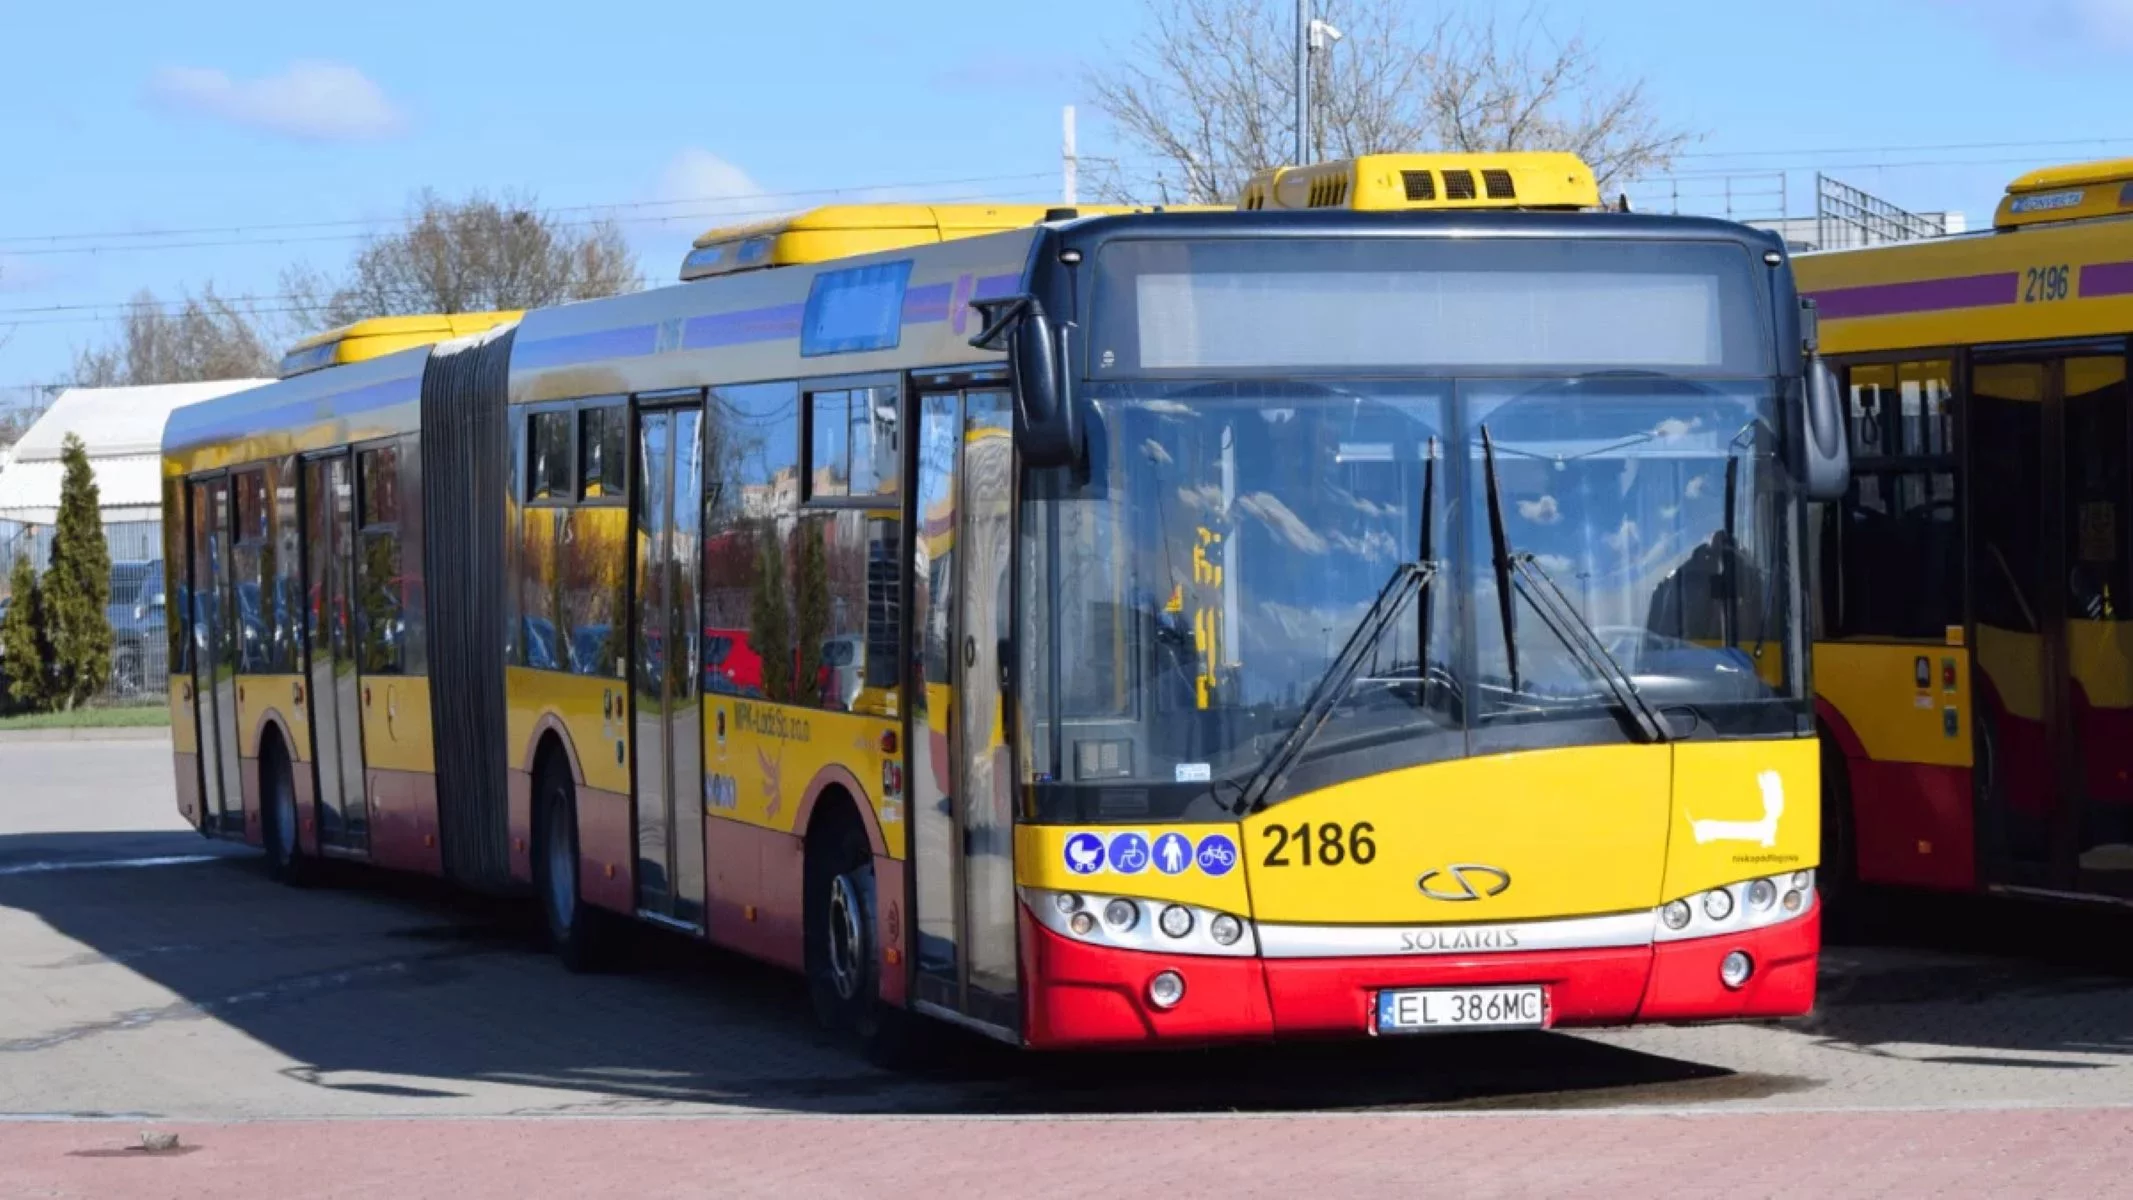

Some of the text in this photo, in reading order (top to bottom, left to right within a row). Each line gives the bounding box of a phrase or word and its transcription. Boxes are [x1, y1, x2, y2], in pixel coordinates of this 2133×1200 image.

[2025, 264, 2069, 302] 2196
[1263, 821, 1376, 867] 2186
[1400, 928, 1519, 950] SOLARIS
[1399, 996, 1438, 1024] EL
[1451, 992, 1537, 1023] 386MC
